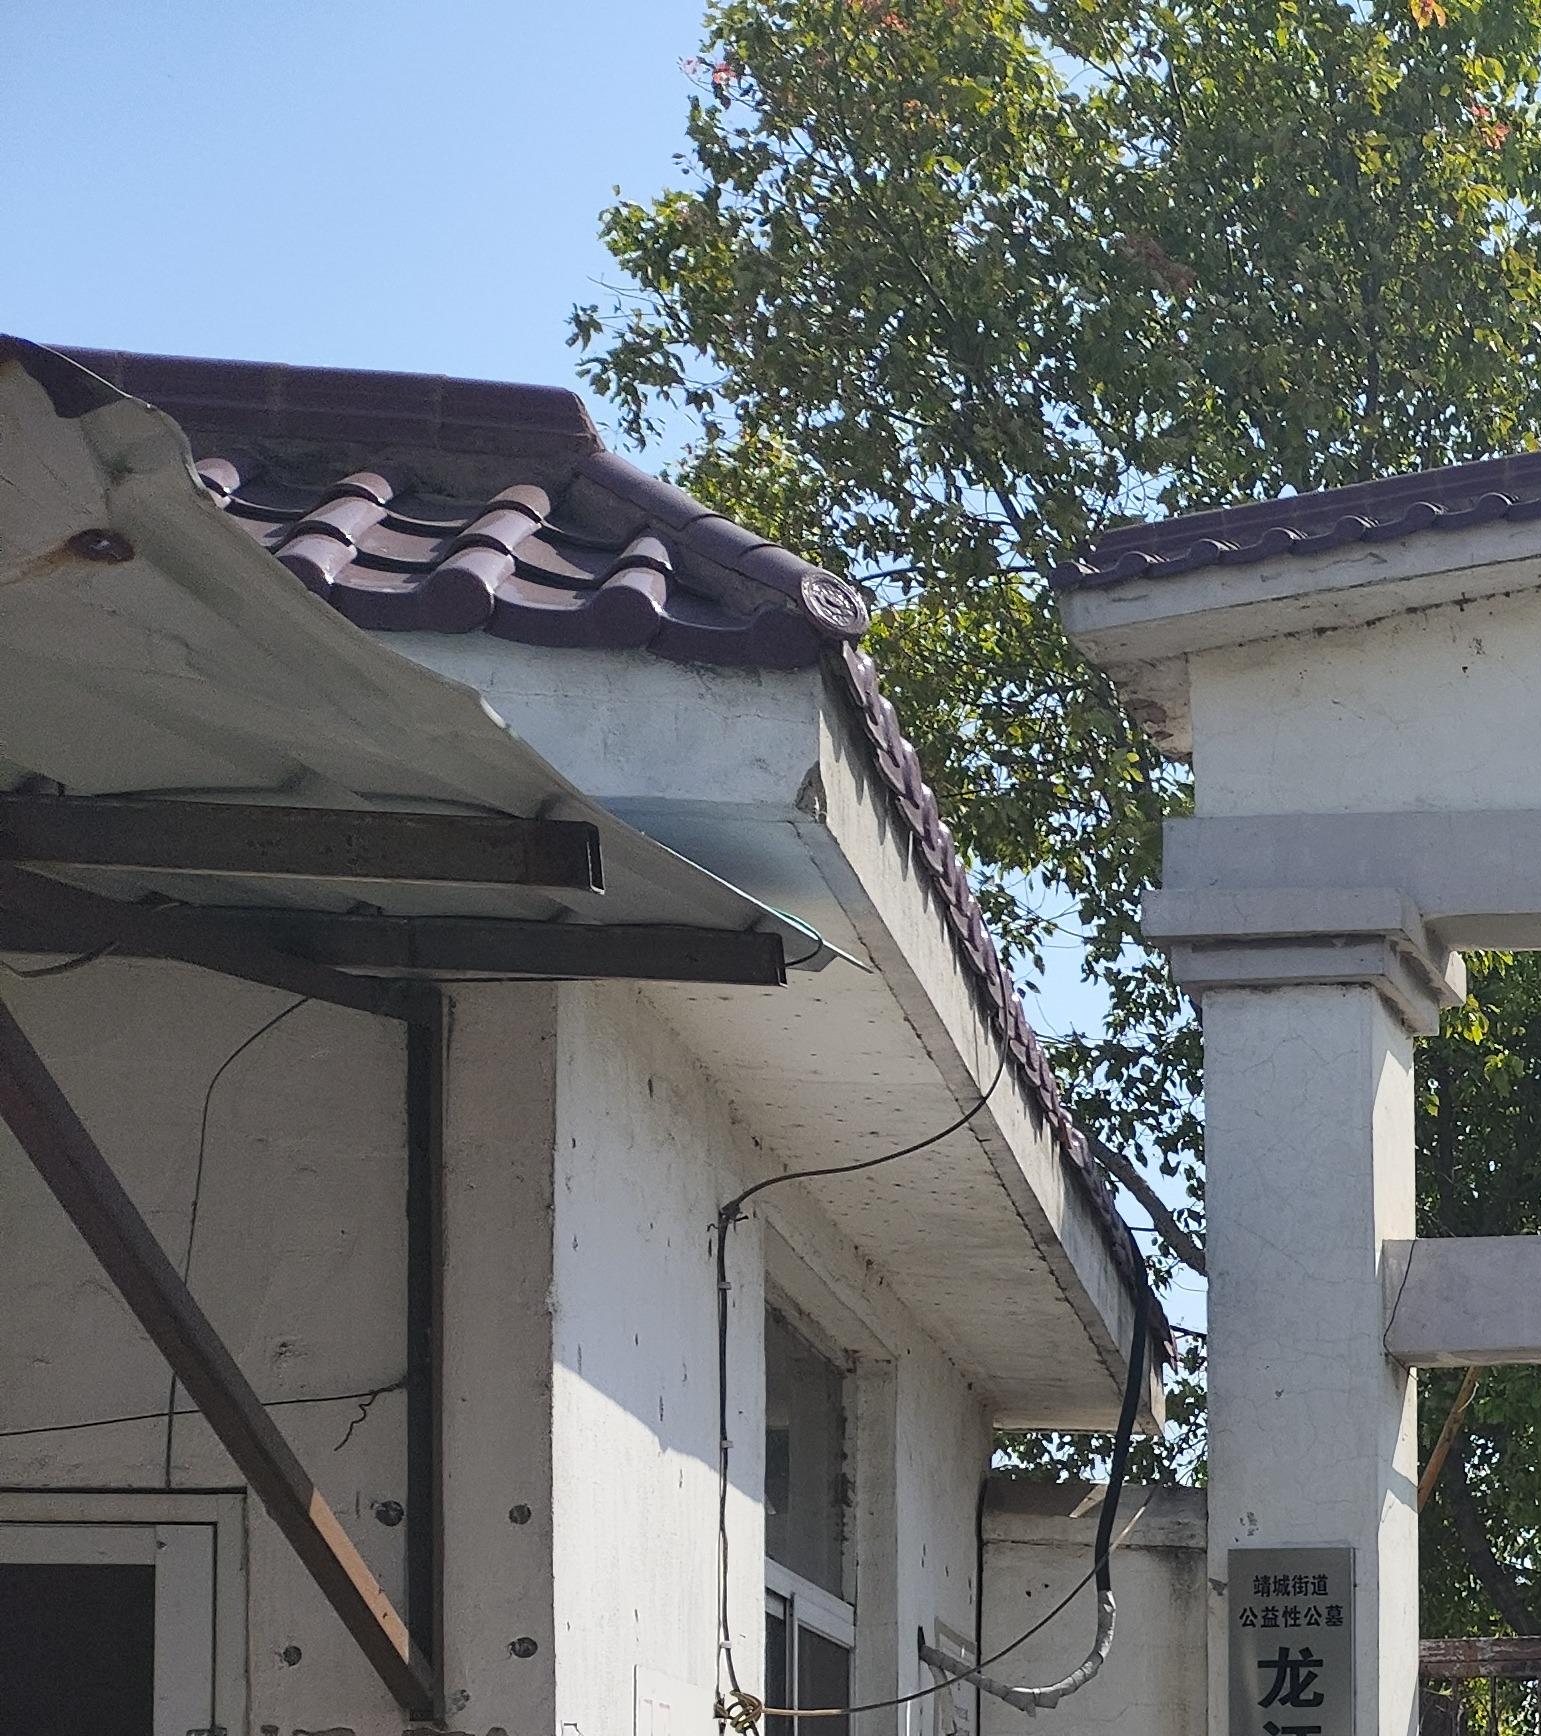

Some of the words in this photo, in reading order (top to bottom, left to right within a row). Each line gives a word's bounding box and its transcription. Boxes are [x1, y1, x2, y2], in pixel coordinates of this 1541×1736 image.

[1252, 1574, 1330, 1597] 靖城街道
[1239, 1604, 1345, 1629] 公益性公墓
